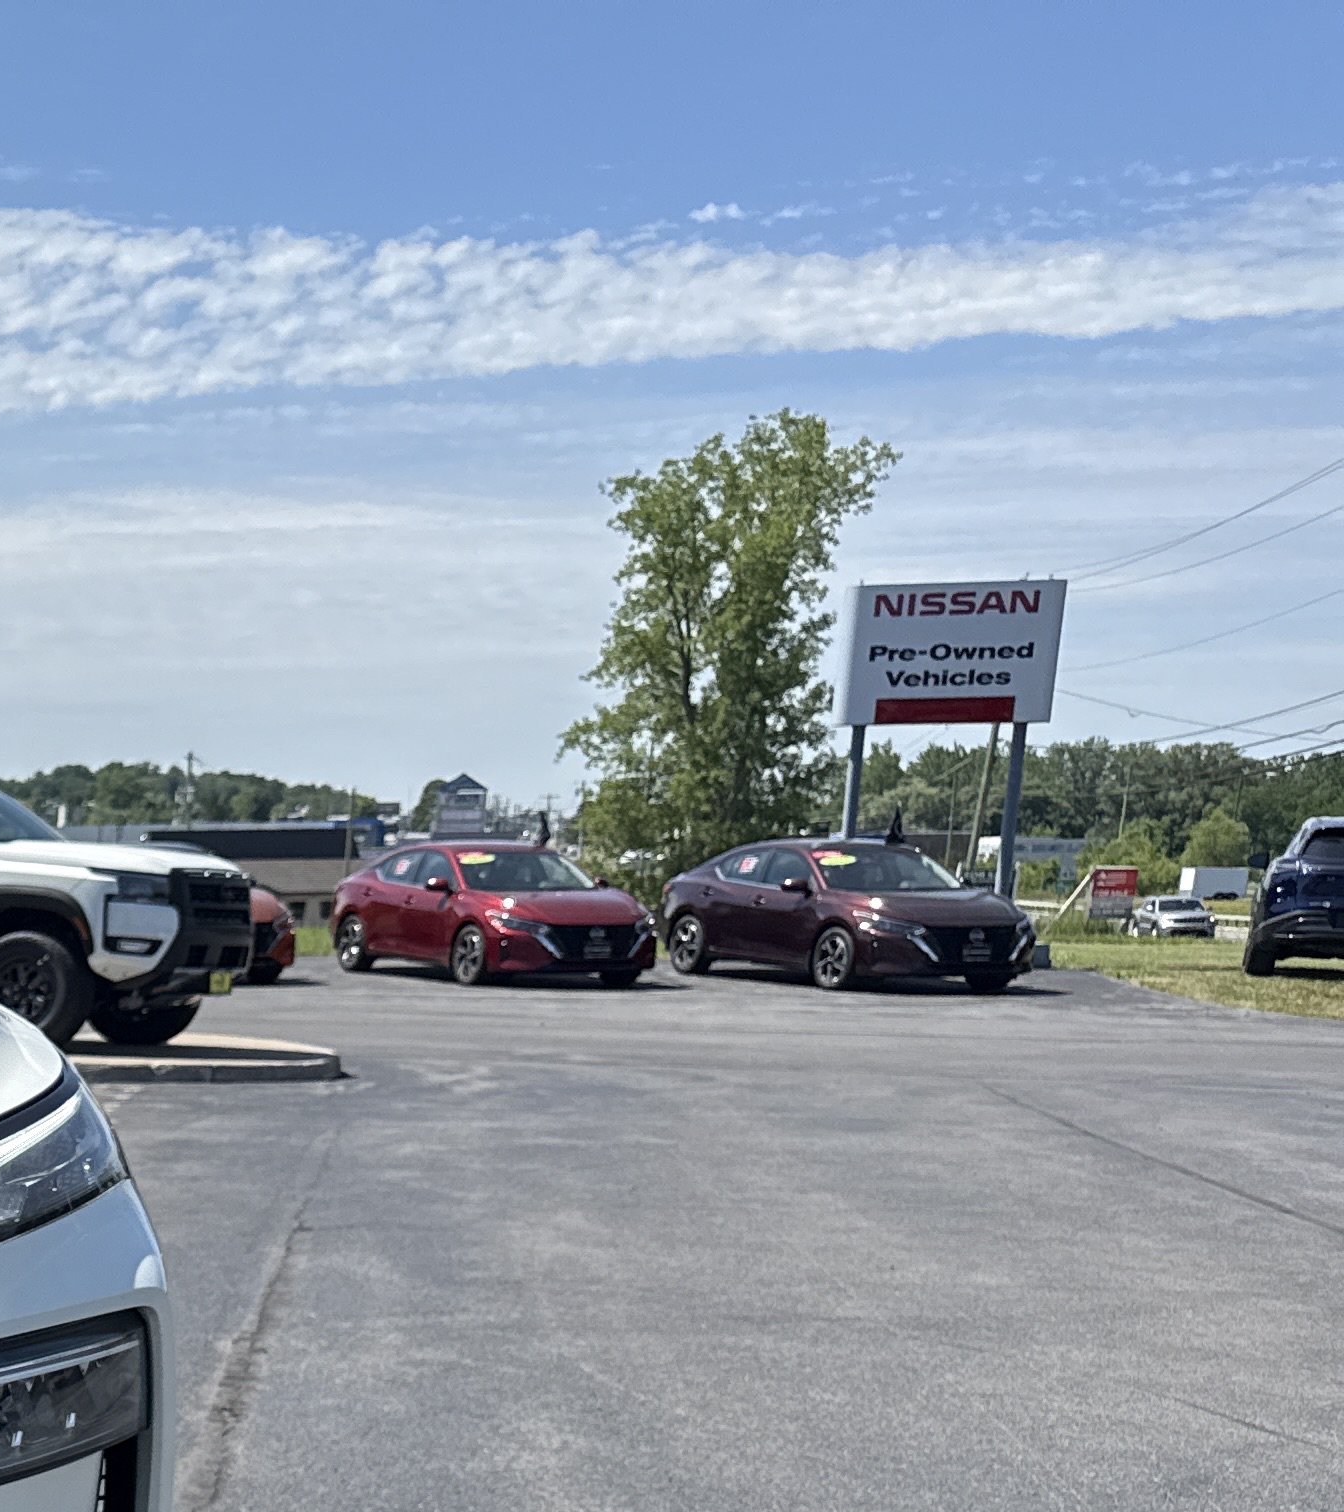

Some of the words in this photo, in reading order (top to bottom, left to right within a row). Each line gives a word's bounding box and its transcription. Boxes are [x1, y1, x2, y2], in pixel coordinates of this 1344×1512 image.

[873, 589, 1041, 617] NISSAN
[869, 642, 1035, 662] Pre-Owned
[886, 669, 1012, 687] Vehicles
